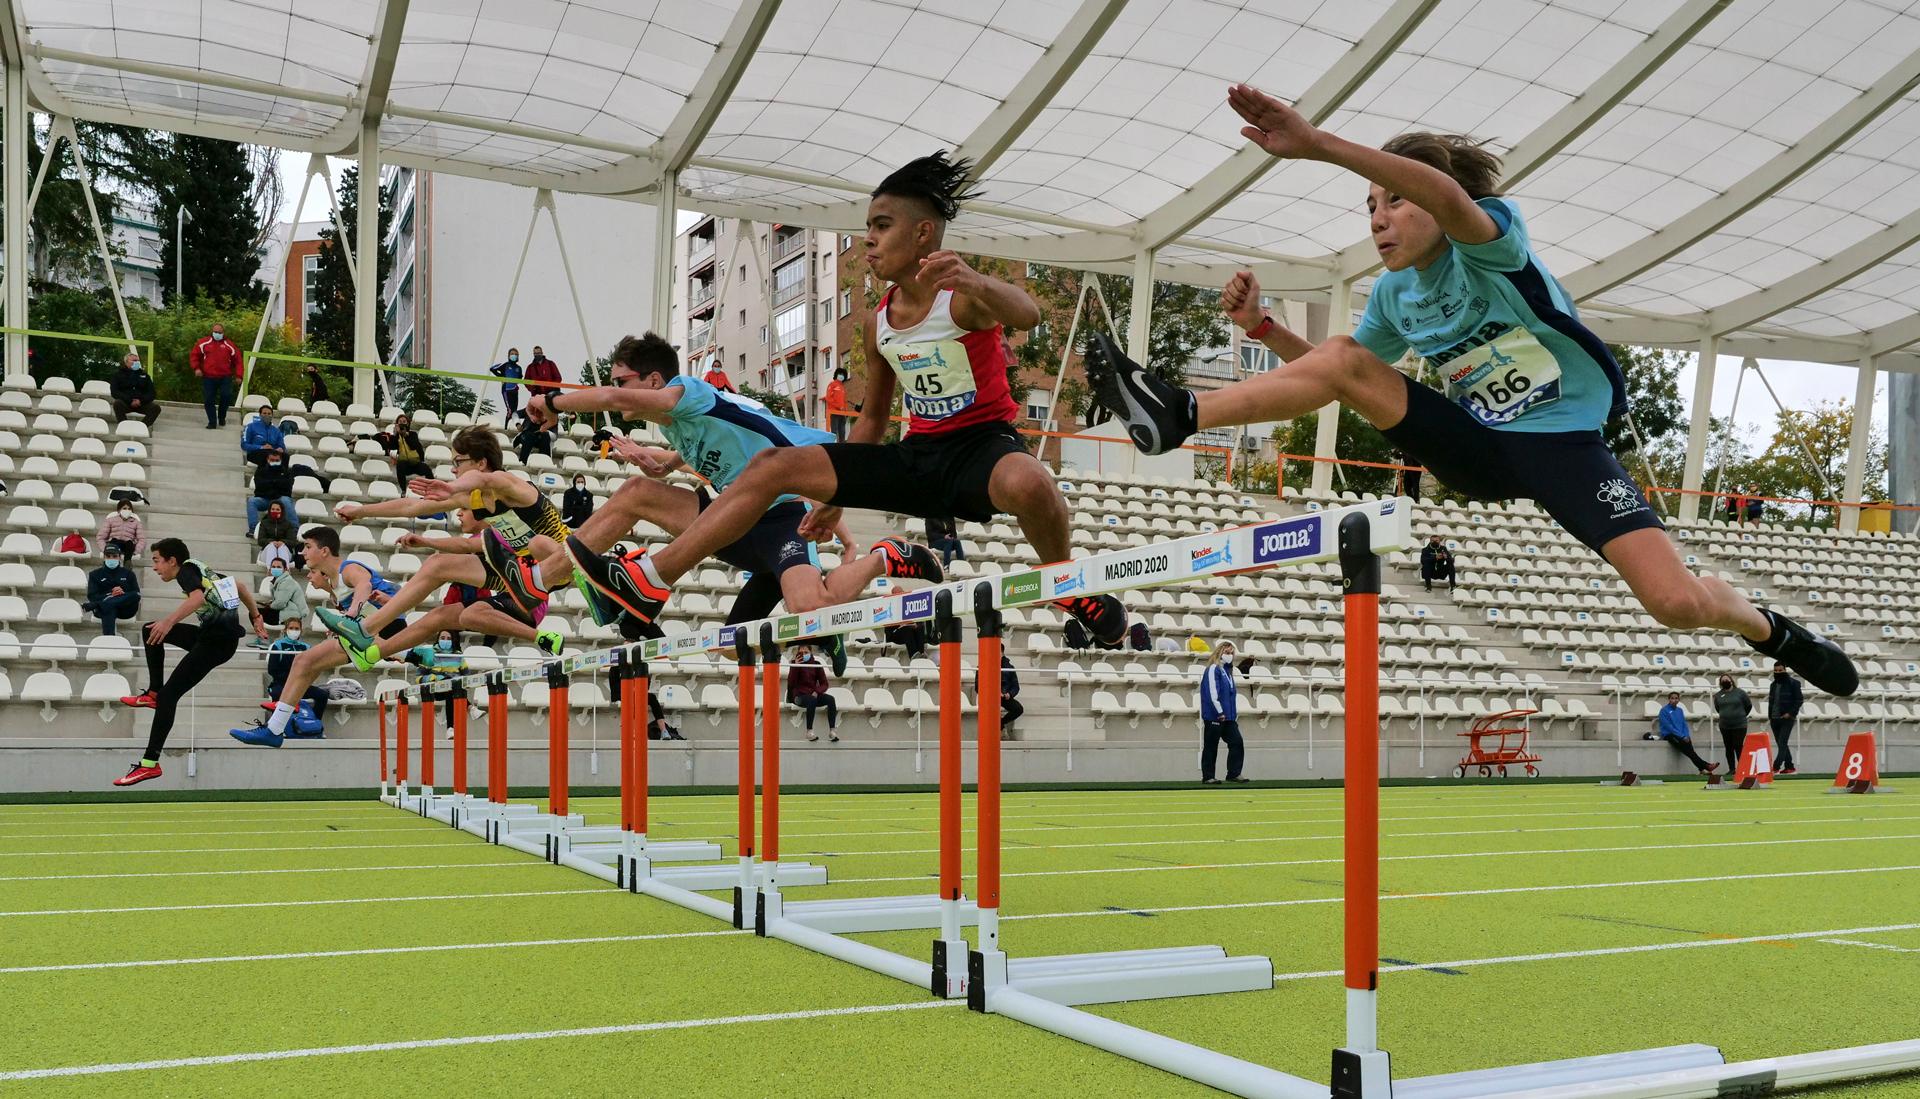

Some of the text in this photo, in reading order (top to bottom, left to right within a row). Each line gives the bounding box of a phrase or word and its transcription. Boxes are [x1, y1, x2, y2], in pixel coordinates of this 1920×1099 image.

[915, 374, 943, 395] 45
[1471, 368, 1530, 416] 166
[1191, 547, 1212, 560] Kinder
[1105, 554, 1168, 580] MADRID 2020
[831, 612, 850, 626] MADRID
[851, 610, 863, 623] 2020
[1845, 752, 1863, 780] 8
